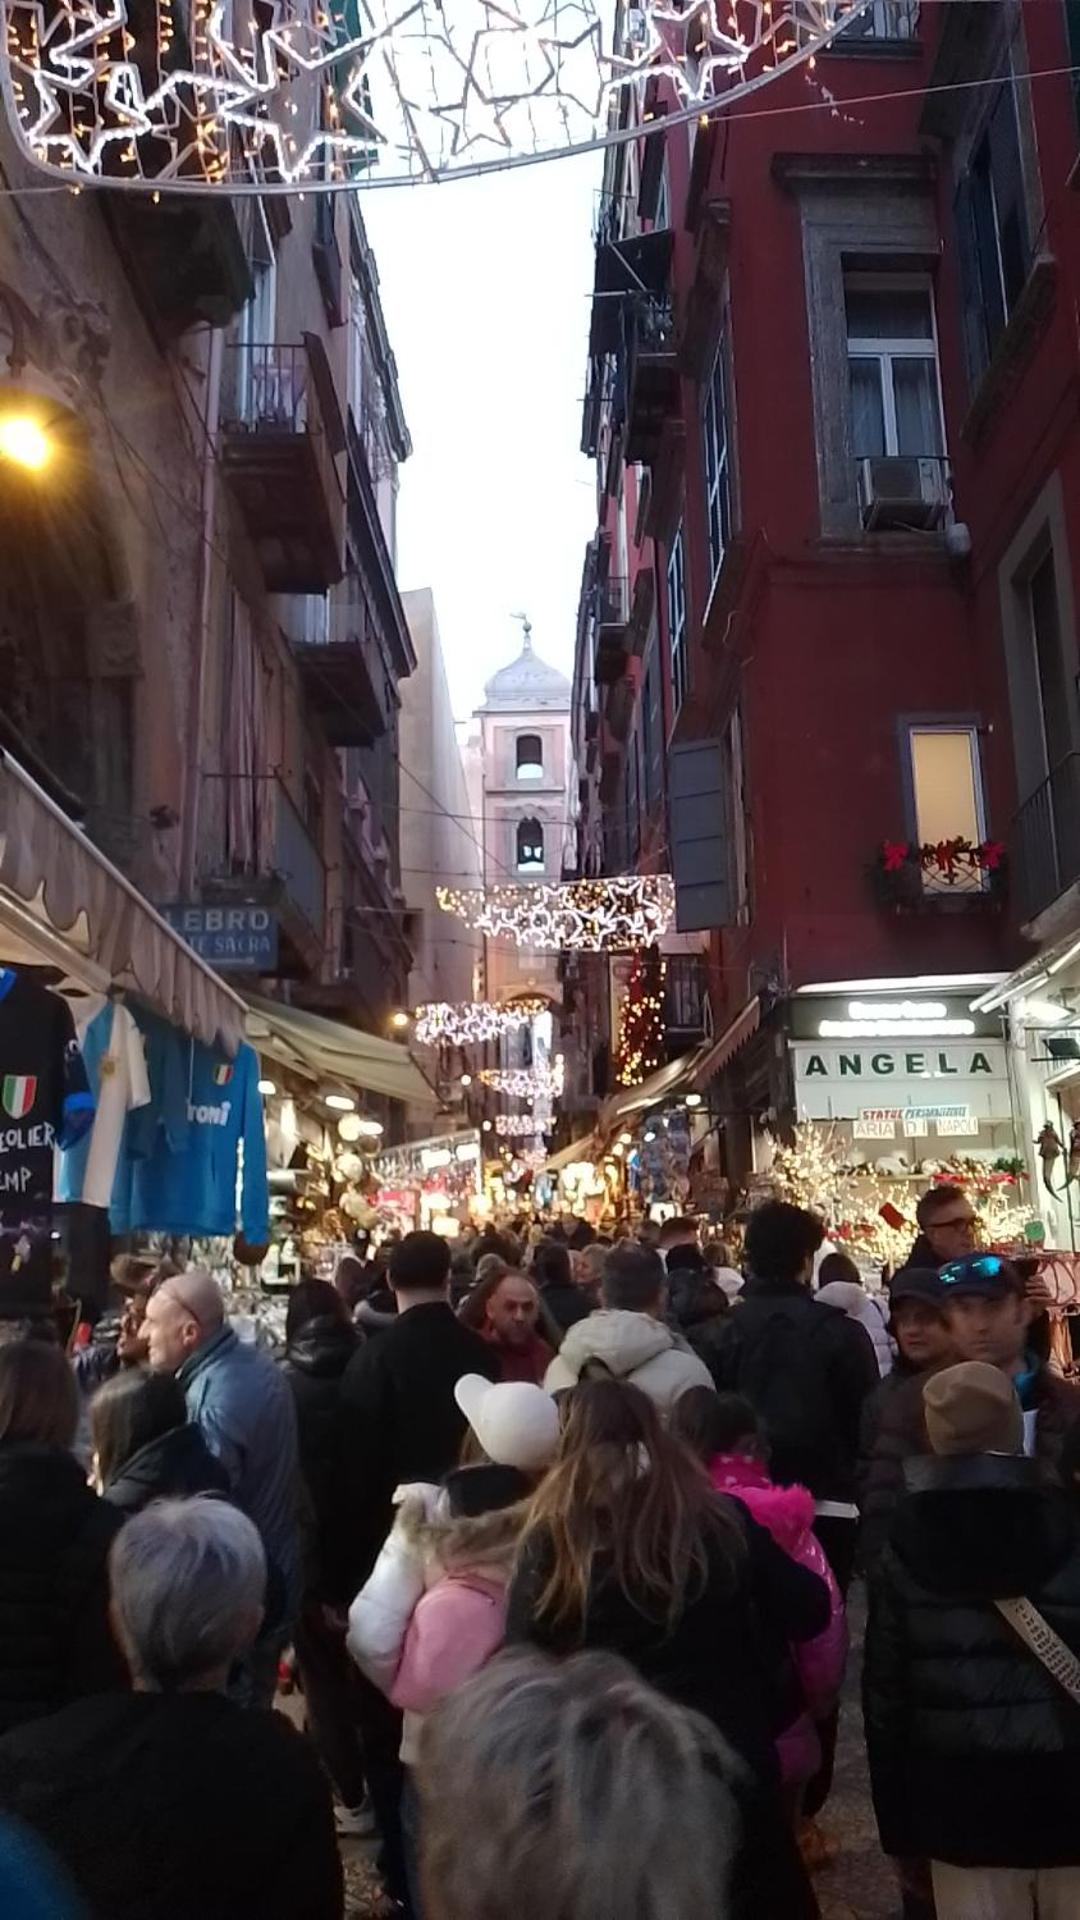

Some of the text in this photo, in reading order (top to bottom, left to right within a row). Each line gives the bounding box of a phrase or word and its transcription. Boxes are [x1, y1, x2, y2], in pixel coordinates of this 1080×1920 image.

[805, 1052, 993, 1076] ANGELA
[856, 1117, 978, 1137] ARIA DI NAPOLI
